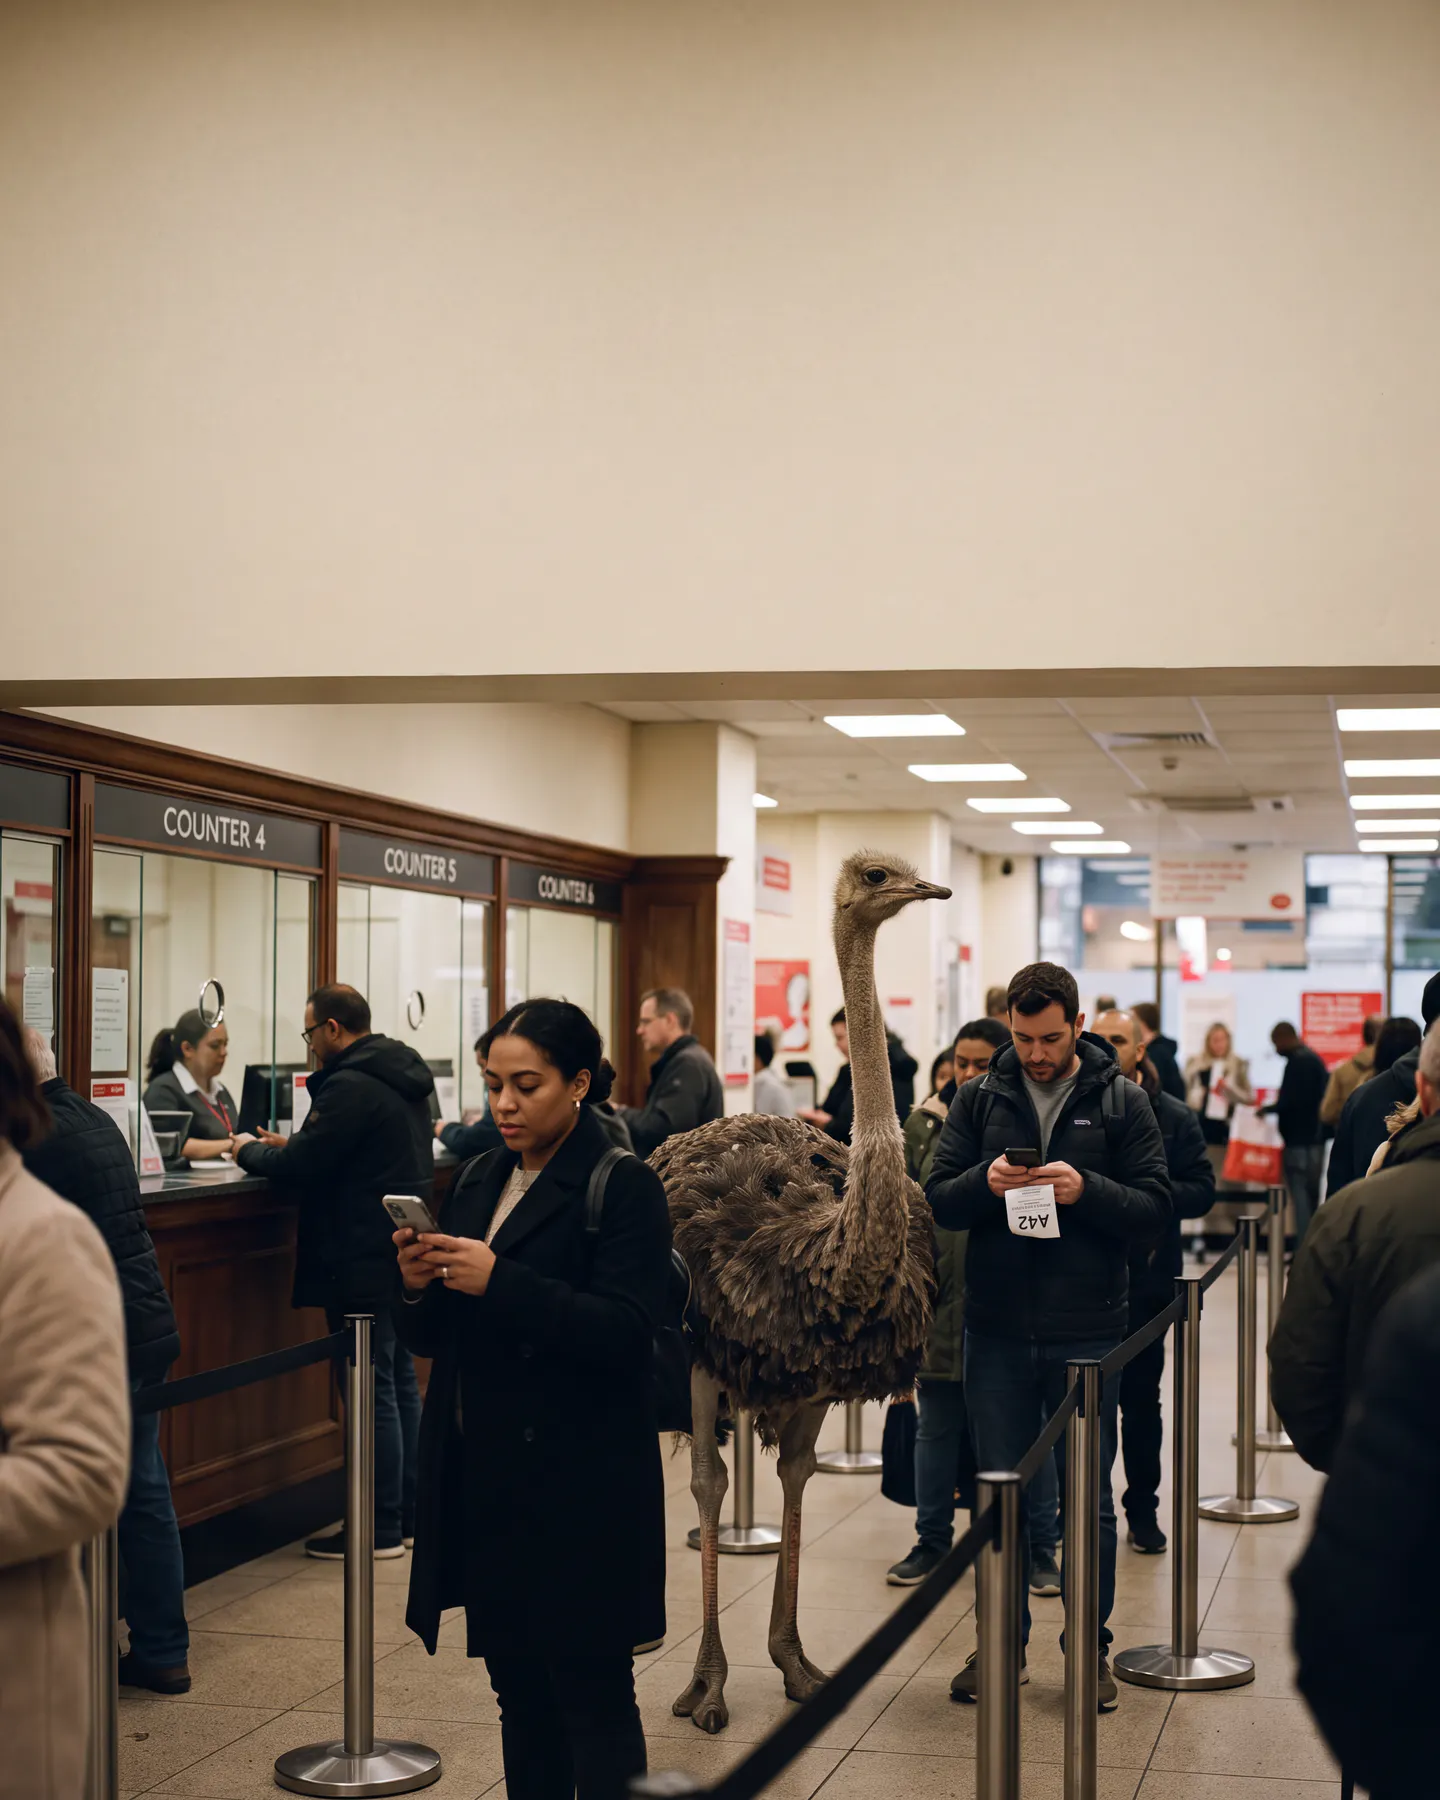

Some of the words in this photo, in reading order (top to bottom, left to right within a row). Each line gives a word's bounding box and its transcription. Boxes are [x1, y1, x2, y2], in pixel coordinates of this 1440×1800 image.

[164, 807, 250, 848] COUNTER
[255, 824, 266, 851] 4
[384, 848, 446, 881] COUNTER
[448, 858, 457, 883] 5
[538, 875, 587, 903] COUNTER
[588, 882, 595, 905] 6
[1018, 1214, 1049, 1230] A42
